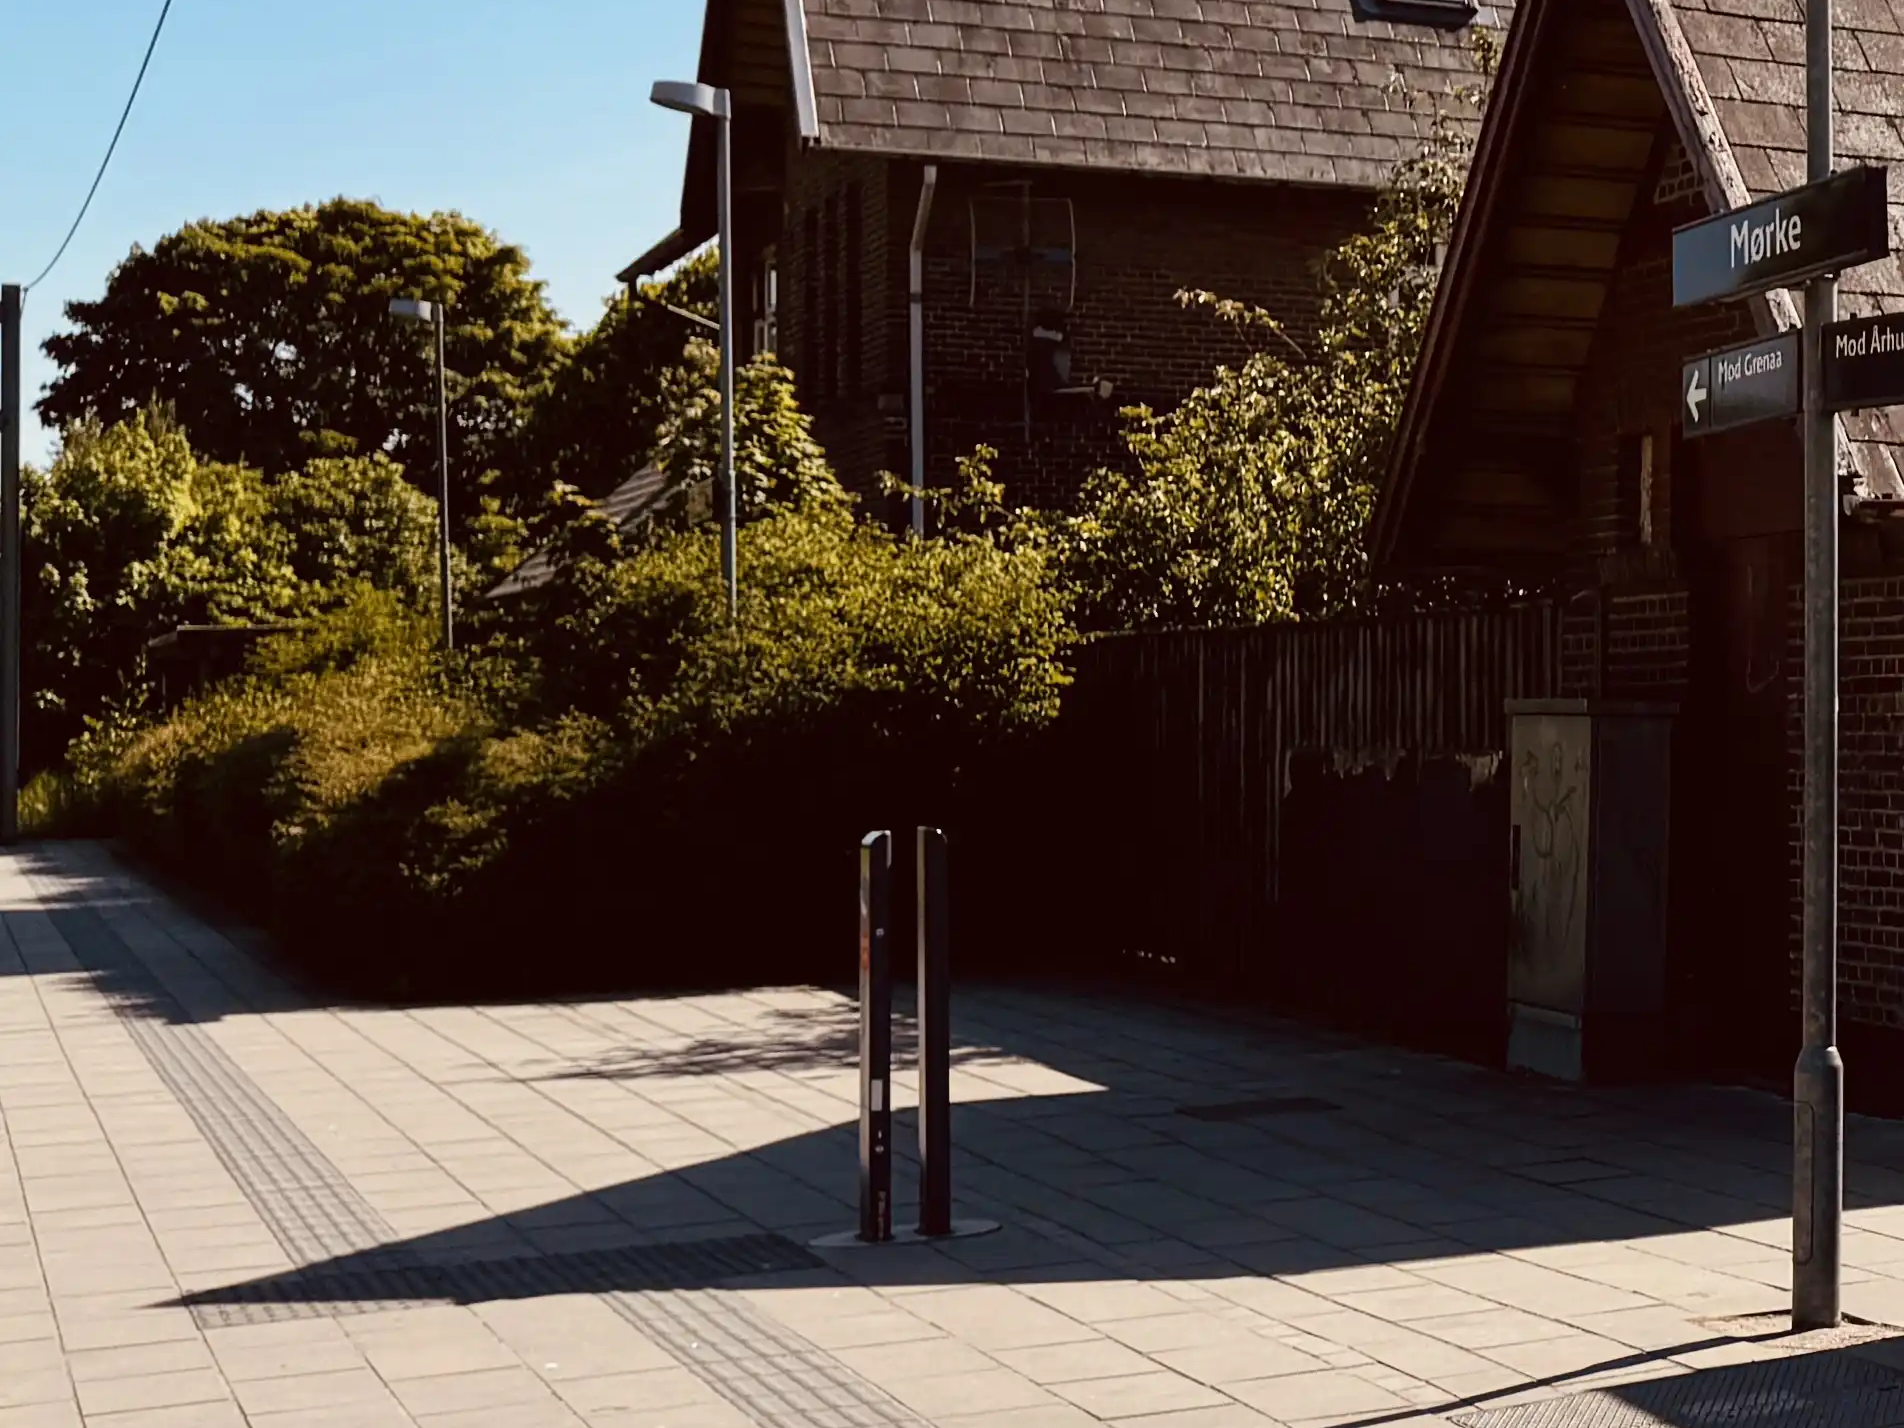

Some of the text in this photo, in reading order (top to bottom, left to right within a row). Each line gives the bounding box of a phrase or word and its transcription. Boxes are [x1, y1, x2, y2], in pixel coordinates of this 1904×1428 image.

[1730, 207, 1802, 269] Mørke
[1836, 331, 1867, 359] Mod
[1718, 350, 1783, 385] Mod Grenaa
